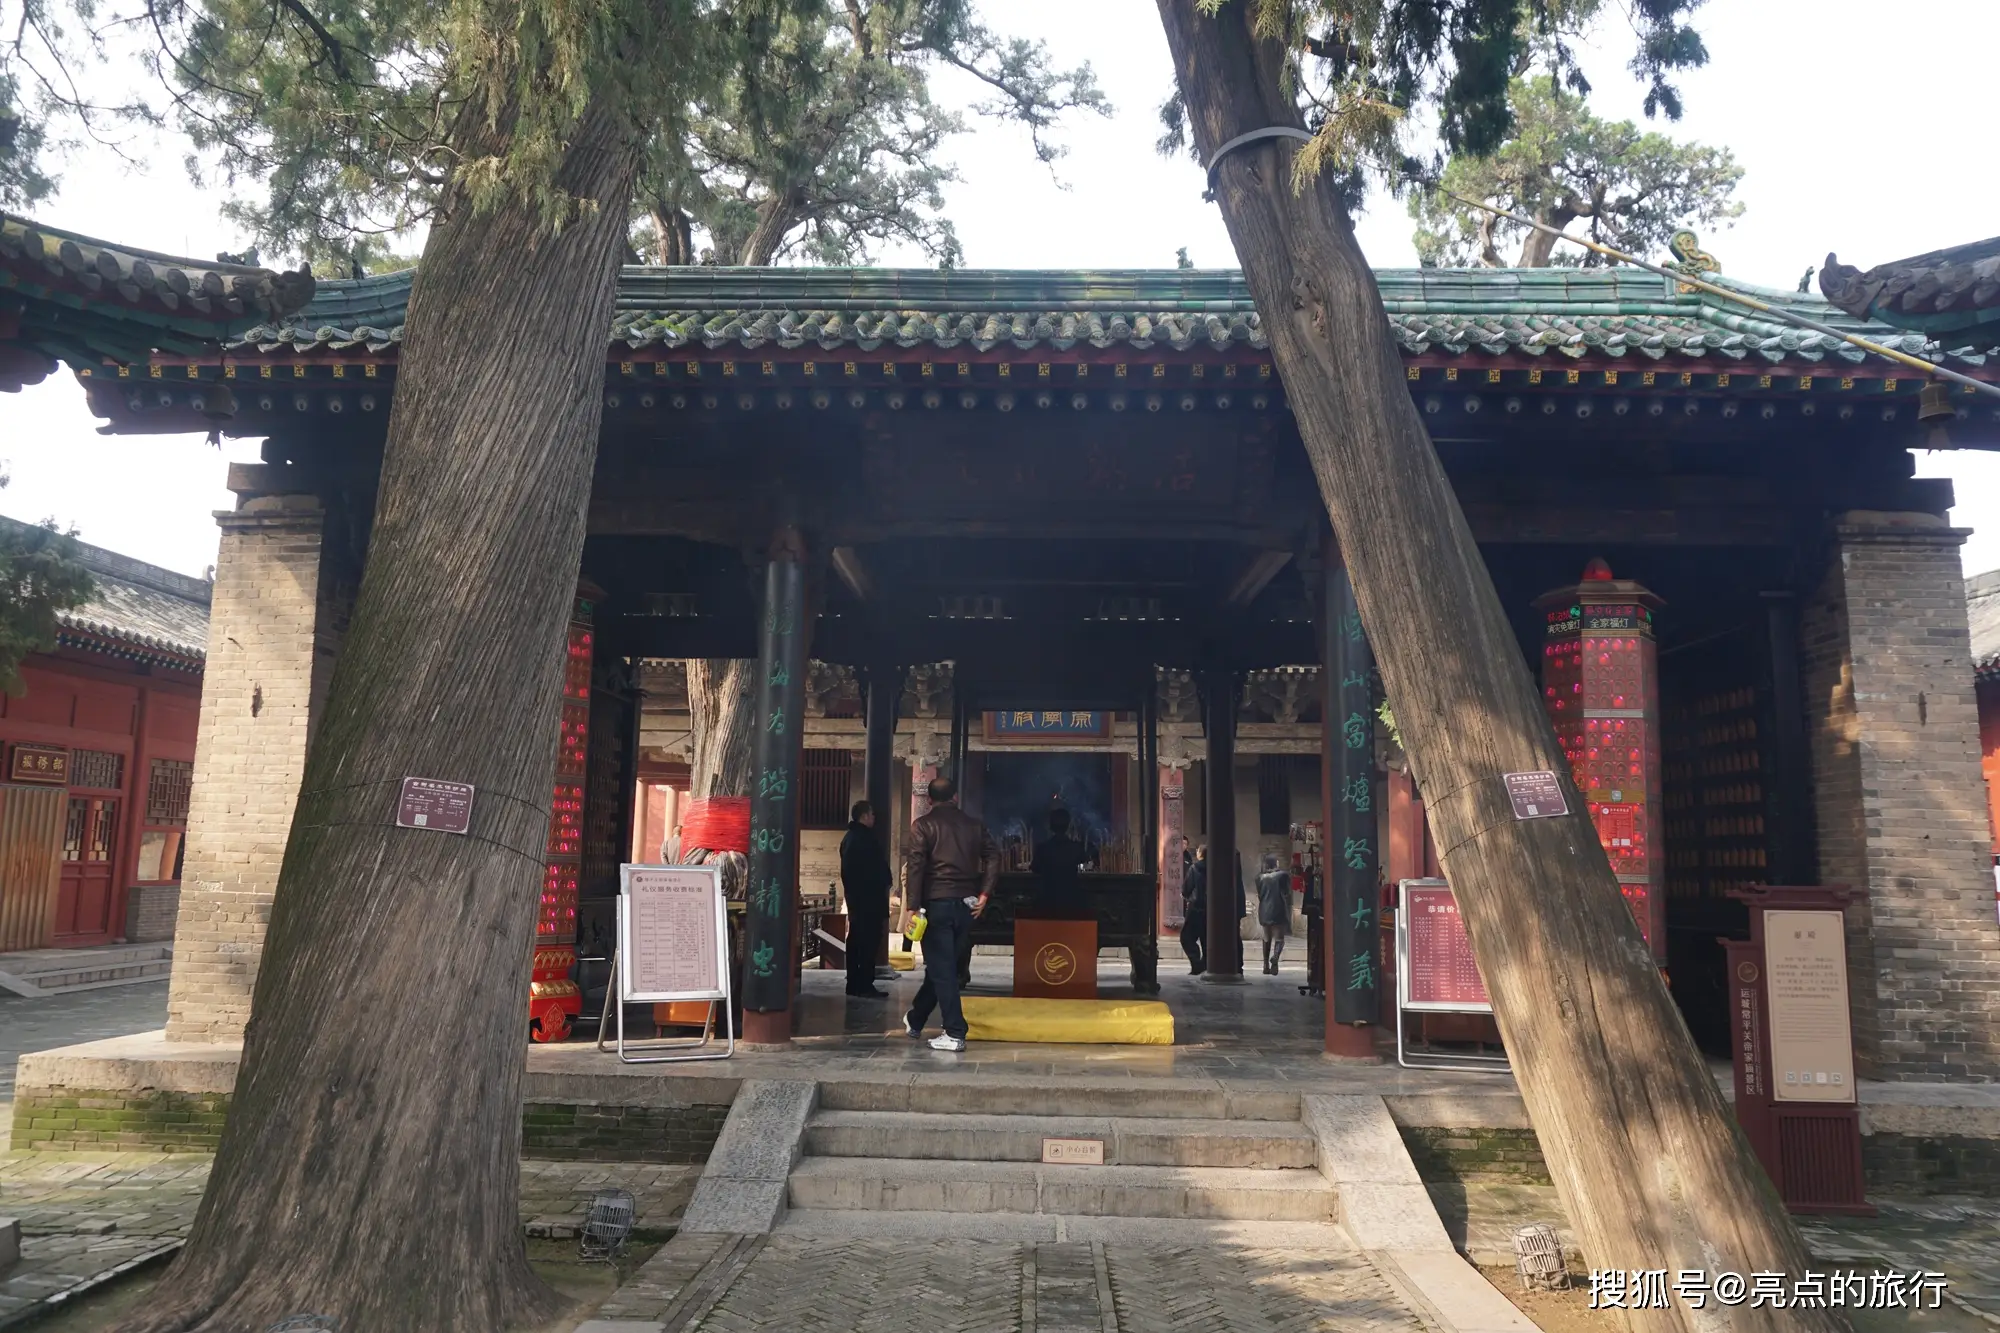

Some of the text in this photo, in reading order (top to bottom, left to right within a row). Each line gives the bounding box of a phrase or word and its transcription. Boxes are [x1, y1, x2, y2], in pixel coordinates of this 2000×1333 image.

[1589, 617, 1629, 628] 全家福灯
[641, 885, 703, 893] 礼仪服务收费标准
[1427, 905, 1461, 914] 恭请价
[1740, 988, 1756, 1095] 运城常平关帝家庙景区
[1066, 1145, 1096, 1154] 小心台阶
